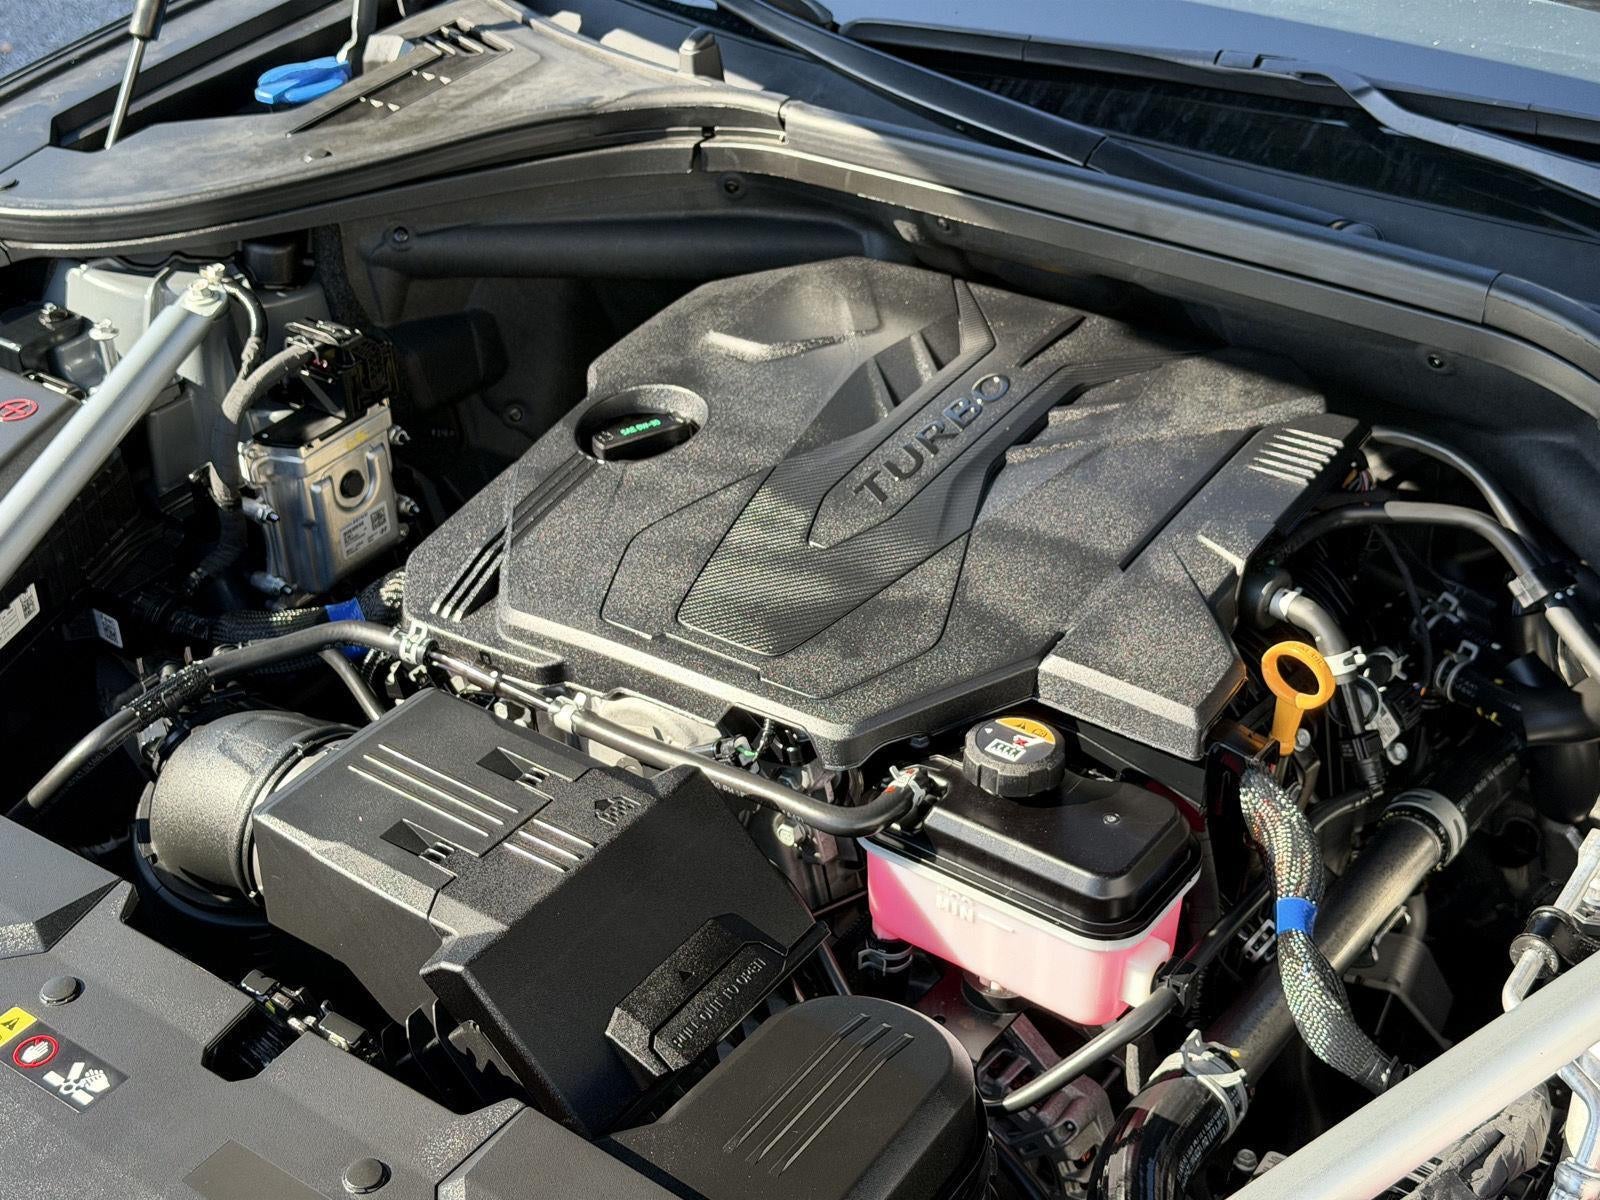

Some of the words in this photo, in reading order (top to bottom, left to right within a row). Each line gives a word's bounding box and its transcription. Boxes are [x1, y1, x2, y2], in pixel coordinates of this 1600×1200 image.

[852, 373, 1010, 505] TURBO
[672, 1020, 701, 1048] PULL
[699, 996, 724, 1021] OUT
[722, 983, 740, 1000] TO
[736, 958, 767, 984] OPEN
